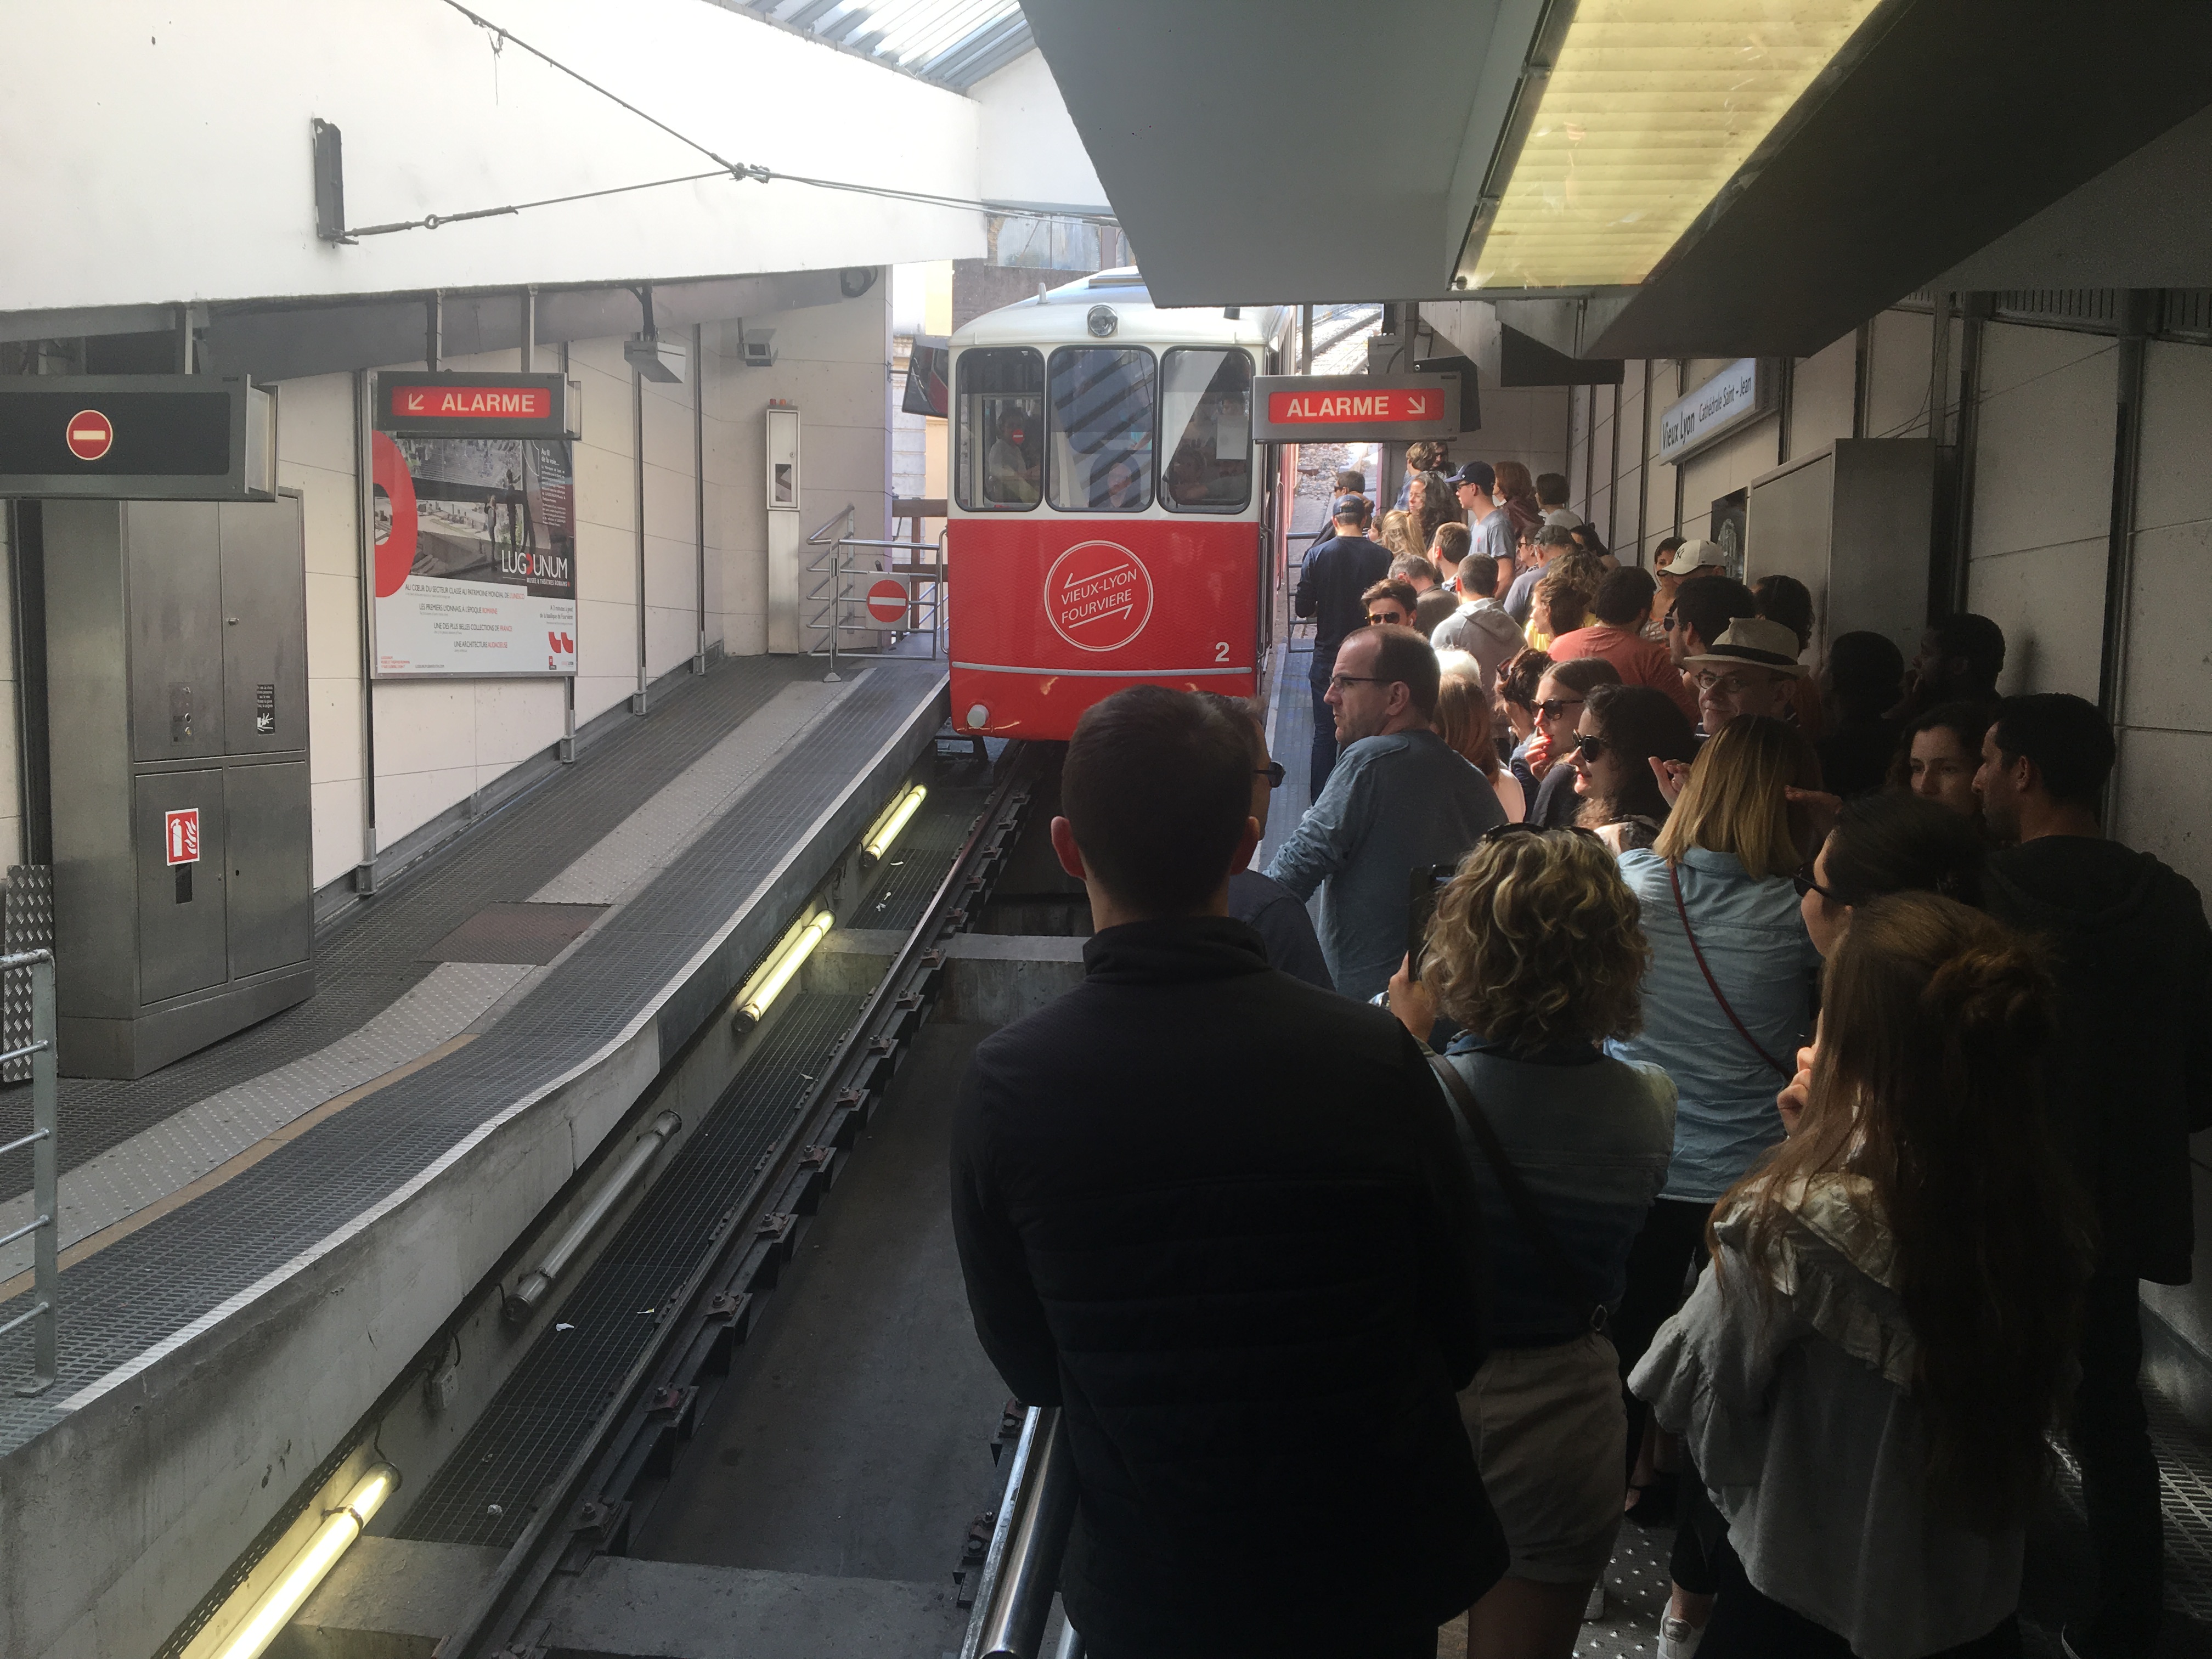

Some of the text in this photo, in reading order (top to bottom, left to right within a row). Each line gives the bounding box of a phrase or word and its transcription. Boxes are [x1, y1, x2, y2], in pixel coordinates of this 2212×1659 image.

[441, 393, 535, 412] ALARME
[1286, 396, 1389, 417] ALARME
[1663, 421, 1679, 449] Vieux
[1680, 411, 1695, 445] Lyon
[1699, 391, 1722, 422] Cathédrale
[1723, 385, 1735, 407] Saint
[1740, 376, 1751, 397] Jean
[468, 589, 488, 597] PATRIMOINE
[1061, 568, 1137, 605] VIEUX-LYON
[1062, 589, 1132, 624] FOURVIERE
[1215, 641, 1229, 662] 2
